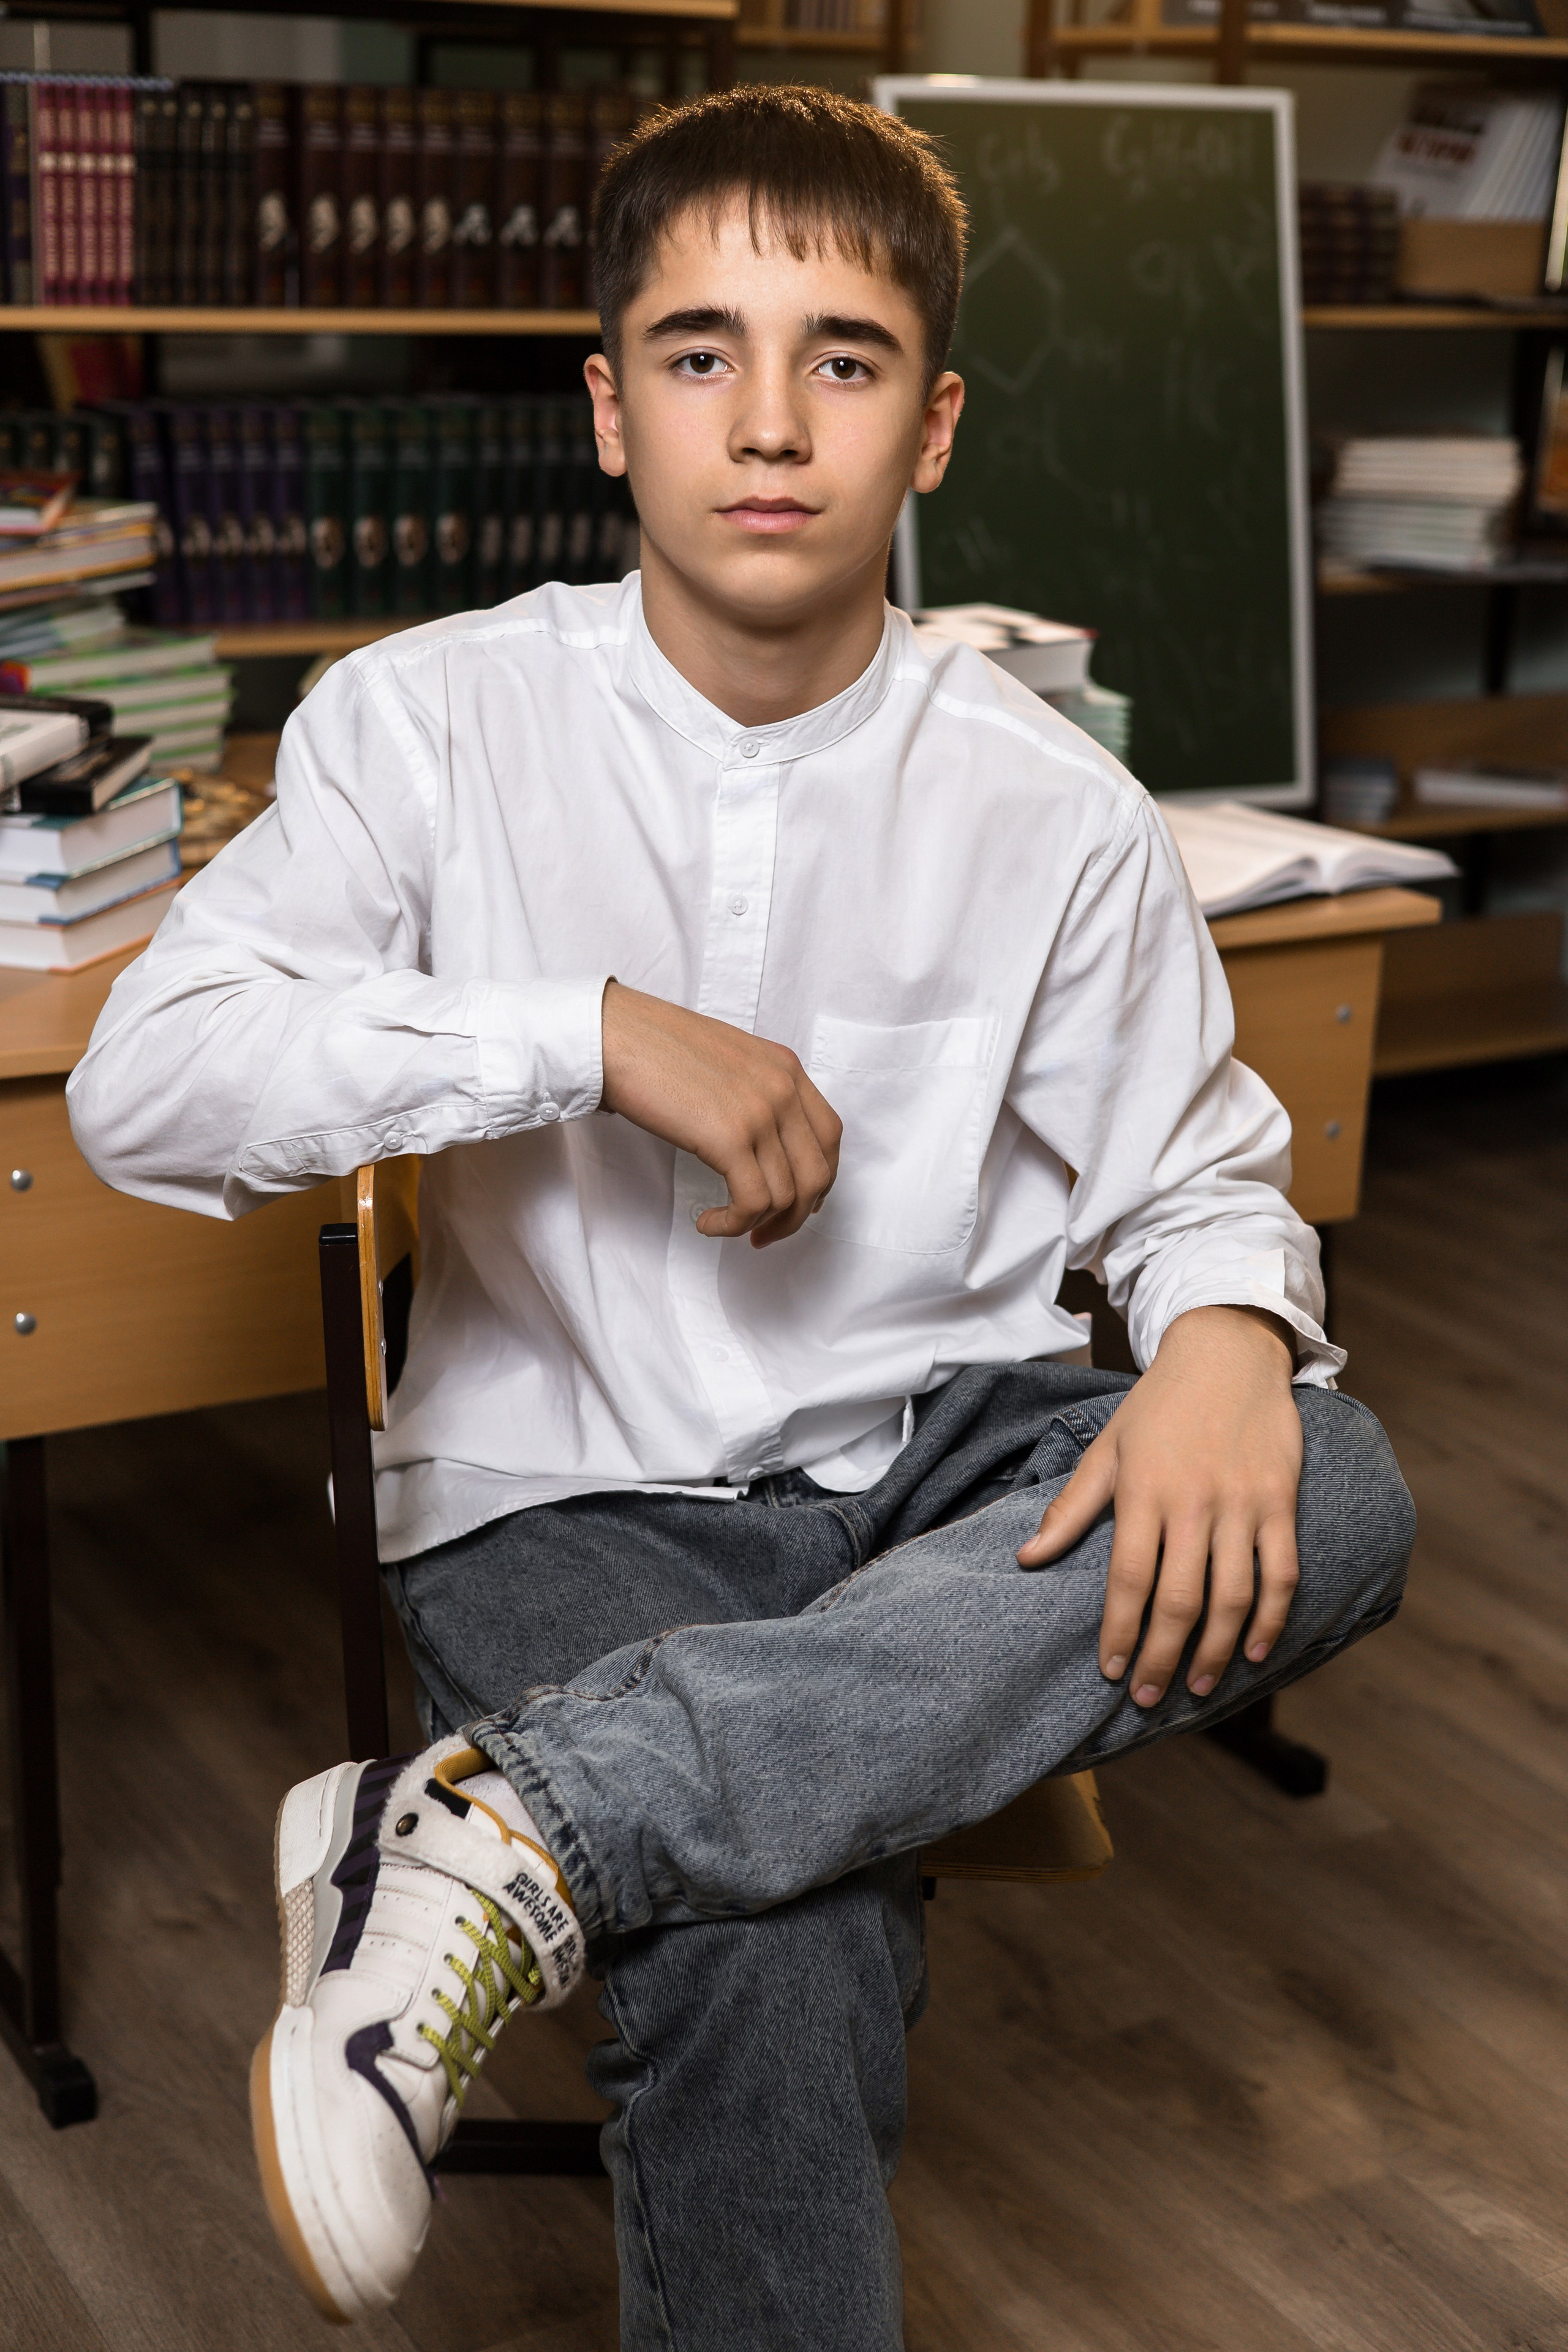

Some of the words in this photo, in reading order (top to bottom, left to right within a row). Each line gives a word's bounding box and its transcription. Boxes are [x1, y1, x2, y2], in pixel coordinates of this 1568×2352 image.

[502, 1880, 557, 1943] AWESOME
[516, 1872, 551, 1907] GIRLS
[547, 1905, 569, 1932] ARE
